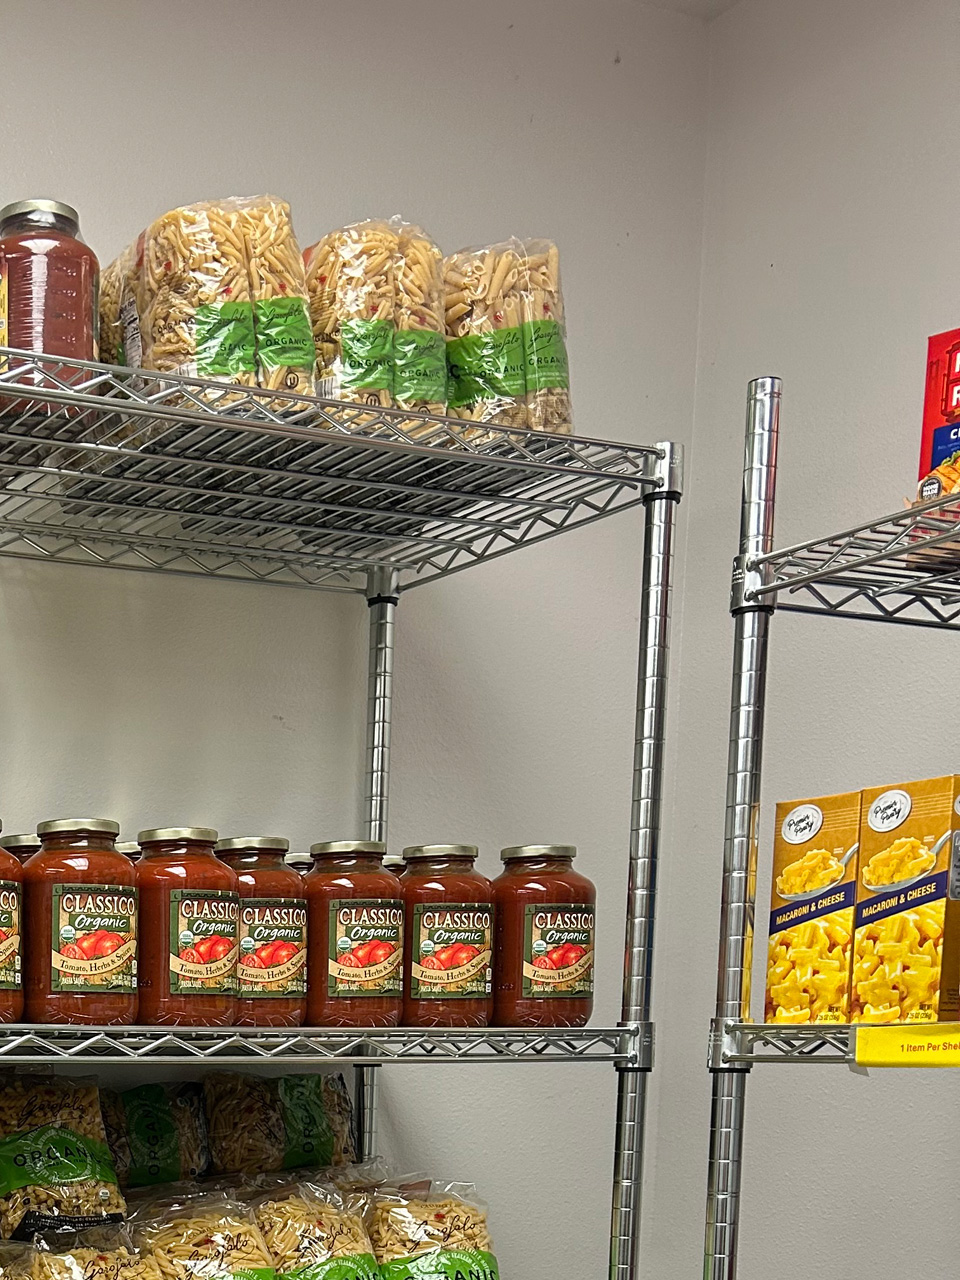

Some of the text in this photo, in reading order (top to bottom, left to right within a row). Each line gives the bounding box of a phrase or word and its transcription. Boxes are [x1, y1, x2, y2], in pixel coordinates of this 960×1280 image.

[266, 338, 307, 347] ORGANIC
[63, 894, 135, 916] CLASSICO
[862, 882, 936, 918] MACARONI & CHEESE
[182, 900, 239, 920] CLASSICO
[776, 891, 845, 926] MACARONI & CHEESE
[75, 915, 127, 930] Organic
[243, 908, 306, 926] CLASSICO
[340, 909, 403, 926] CLASSICO
[423, 912, 490, 929] CLASSICO
[536, 913, 593, 929] CLASSICO
[193, 920, 235, 934] Organic
[254, 926, 300, 941] Organic
[351, 926, 397, 940] Organic
[434, 929, 481, 943] Organic
[546, 930, 587, 943] Organic
[60, 959, 88, 973] Tomato,
[90, 961, 110, 972] Herbs
[111, 958, 116, 966] &
[241, 968, 266, 980] Tomato,
[267, 970, 286, 980] Herbs
[420, 969, 445, 982] Tomato,
[446, 971, 465, 981] Herbs
[900, 1042, 960, 1053] 1 Item Per Shel
